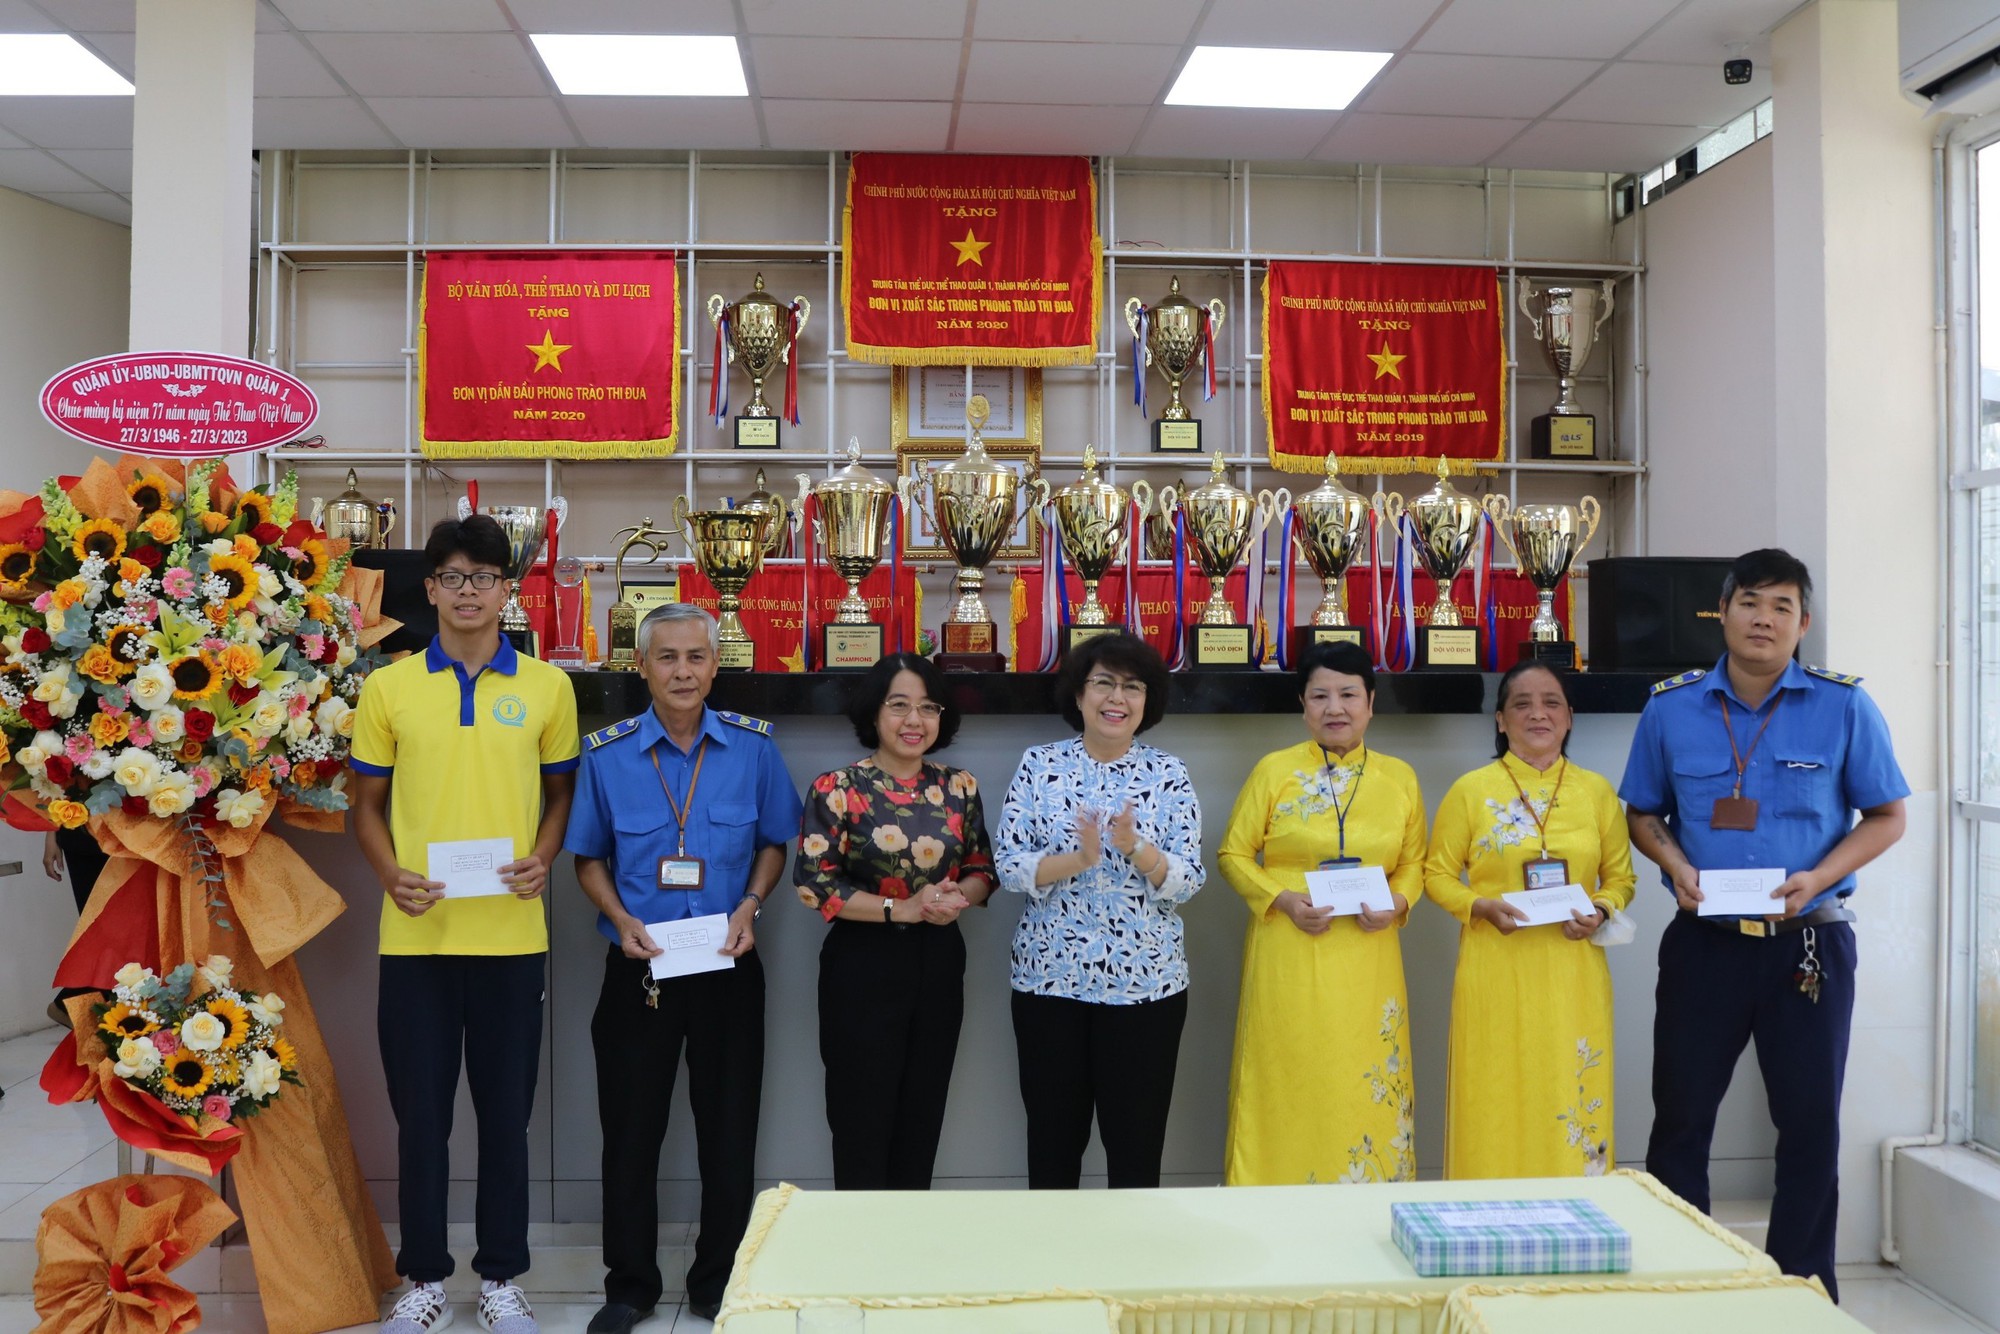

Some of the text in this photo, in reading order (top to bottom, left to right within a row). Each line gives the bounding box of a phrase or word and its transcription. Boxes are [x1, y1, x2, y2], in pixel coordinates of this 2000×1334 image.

[930, 186, 951, 202] CỘNG
[954, 184, 970, 199] HÒA
[970, 186, 981, 199] XÃ
[982, 186, 997, 202] HỘI
[1016, 186, 1040, 200] NGHĨA
[1042, 186, 1059, 204] VIỆT
[1060, 189, 1076, 201] NAM
[943, 206, 998, 218] TẶNG
[448, 275, 650, 301] BỘ VĂN HÓA, THỂ THAO VÀ DU LỊCH
[872, 279, 893, 290] TRUNG
[894, 279, 908, 290] TÂM
[909, 276, 921, 290] THỂ
[922, 280, 935, 293] DỤC
[936, 277, 948, 290] THỂ
[950, 280, 966, 290] THAO
[968, 280, 986, 294] QUẬN
[995, 280, 1016, 290] THÀNH
[1017, 278, 1030, 291] PHỐ
[1031, 278, 1040, 291] HỒ
[1053, 282, 1069, 292] MINH
[528, 306, 570, 320] TẶNG
[869, 296, 1074, 314] ĐƠN VỊ XUẤT SẮC TRONG PHONG TRÀO THI ĐUA
[1345, 298, 1366, 314] CỘNG
[1368, 298, 1382, 312] HÒA
[1383, 299, 1394, 312] XÃ
[1396, 299, 1409, 316] HỘI
[1428, 300, 1451, 312] NGHĨA
[1452, 299, 1468, 314] VIỆT
[1470, 300, 1486, 312] NAM
[936, 318, 1008, 329] NĂM 2020
[1359, 319, 1411, 332] TẶNG
[74, 363, 290, 402] QUẬN ỦY-UBND-UBMTTQVN QUẬN 1
[453, 381, 646, 404] ĐƠN VỊ DẪN ĐẦU PHONG TRÀO THI ĐUA
[1297, 390, 1315, 400] TRUNG
[1317, 389, 1329, 400] TÂM
[1342, 392, 1354, 404] DỤC
[1368, 394, 1383, 402] THAO
[1384, 392, 1401, 406] QUẬN
[1410, 392, 1428, 403] THÀNH
[1429, 390, 1440, 403] PHỐ
[1441, 390, 1450, 402] HỒ
[1461, 392, 1476, 402] MINH
[58, 396, 304, 427] Chúc mừng kỷ niệm 77 năm ngày Thể Thao Việt Nam
[514, 408, 586, 420] NĂM 2020
[1291, 407, 1488, 425] ĐƠN VỊ XUẤT SẮC TRONG PHONG TRÀO THI ĐUA
[120, 427, 180, 444] 27/3/1946
[190, 428, 248, 444] 27/3/2023
[1356, 432, 1424, 442] NĂM 2019
[758, 596, 779, 612] CỘNG
[781, 598, 796, 612] HÒA
[1140, 601, 1170, 614] THAO
[1508, 606, 1522, 618] DU
